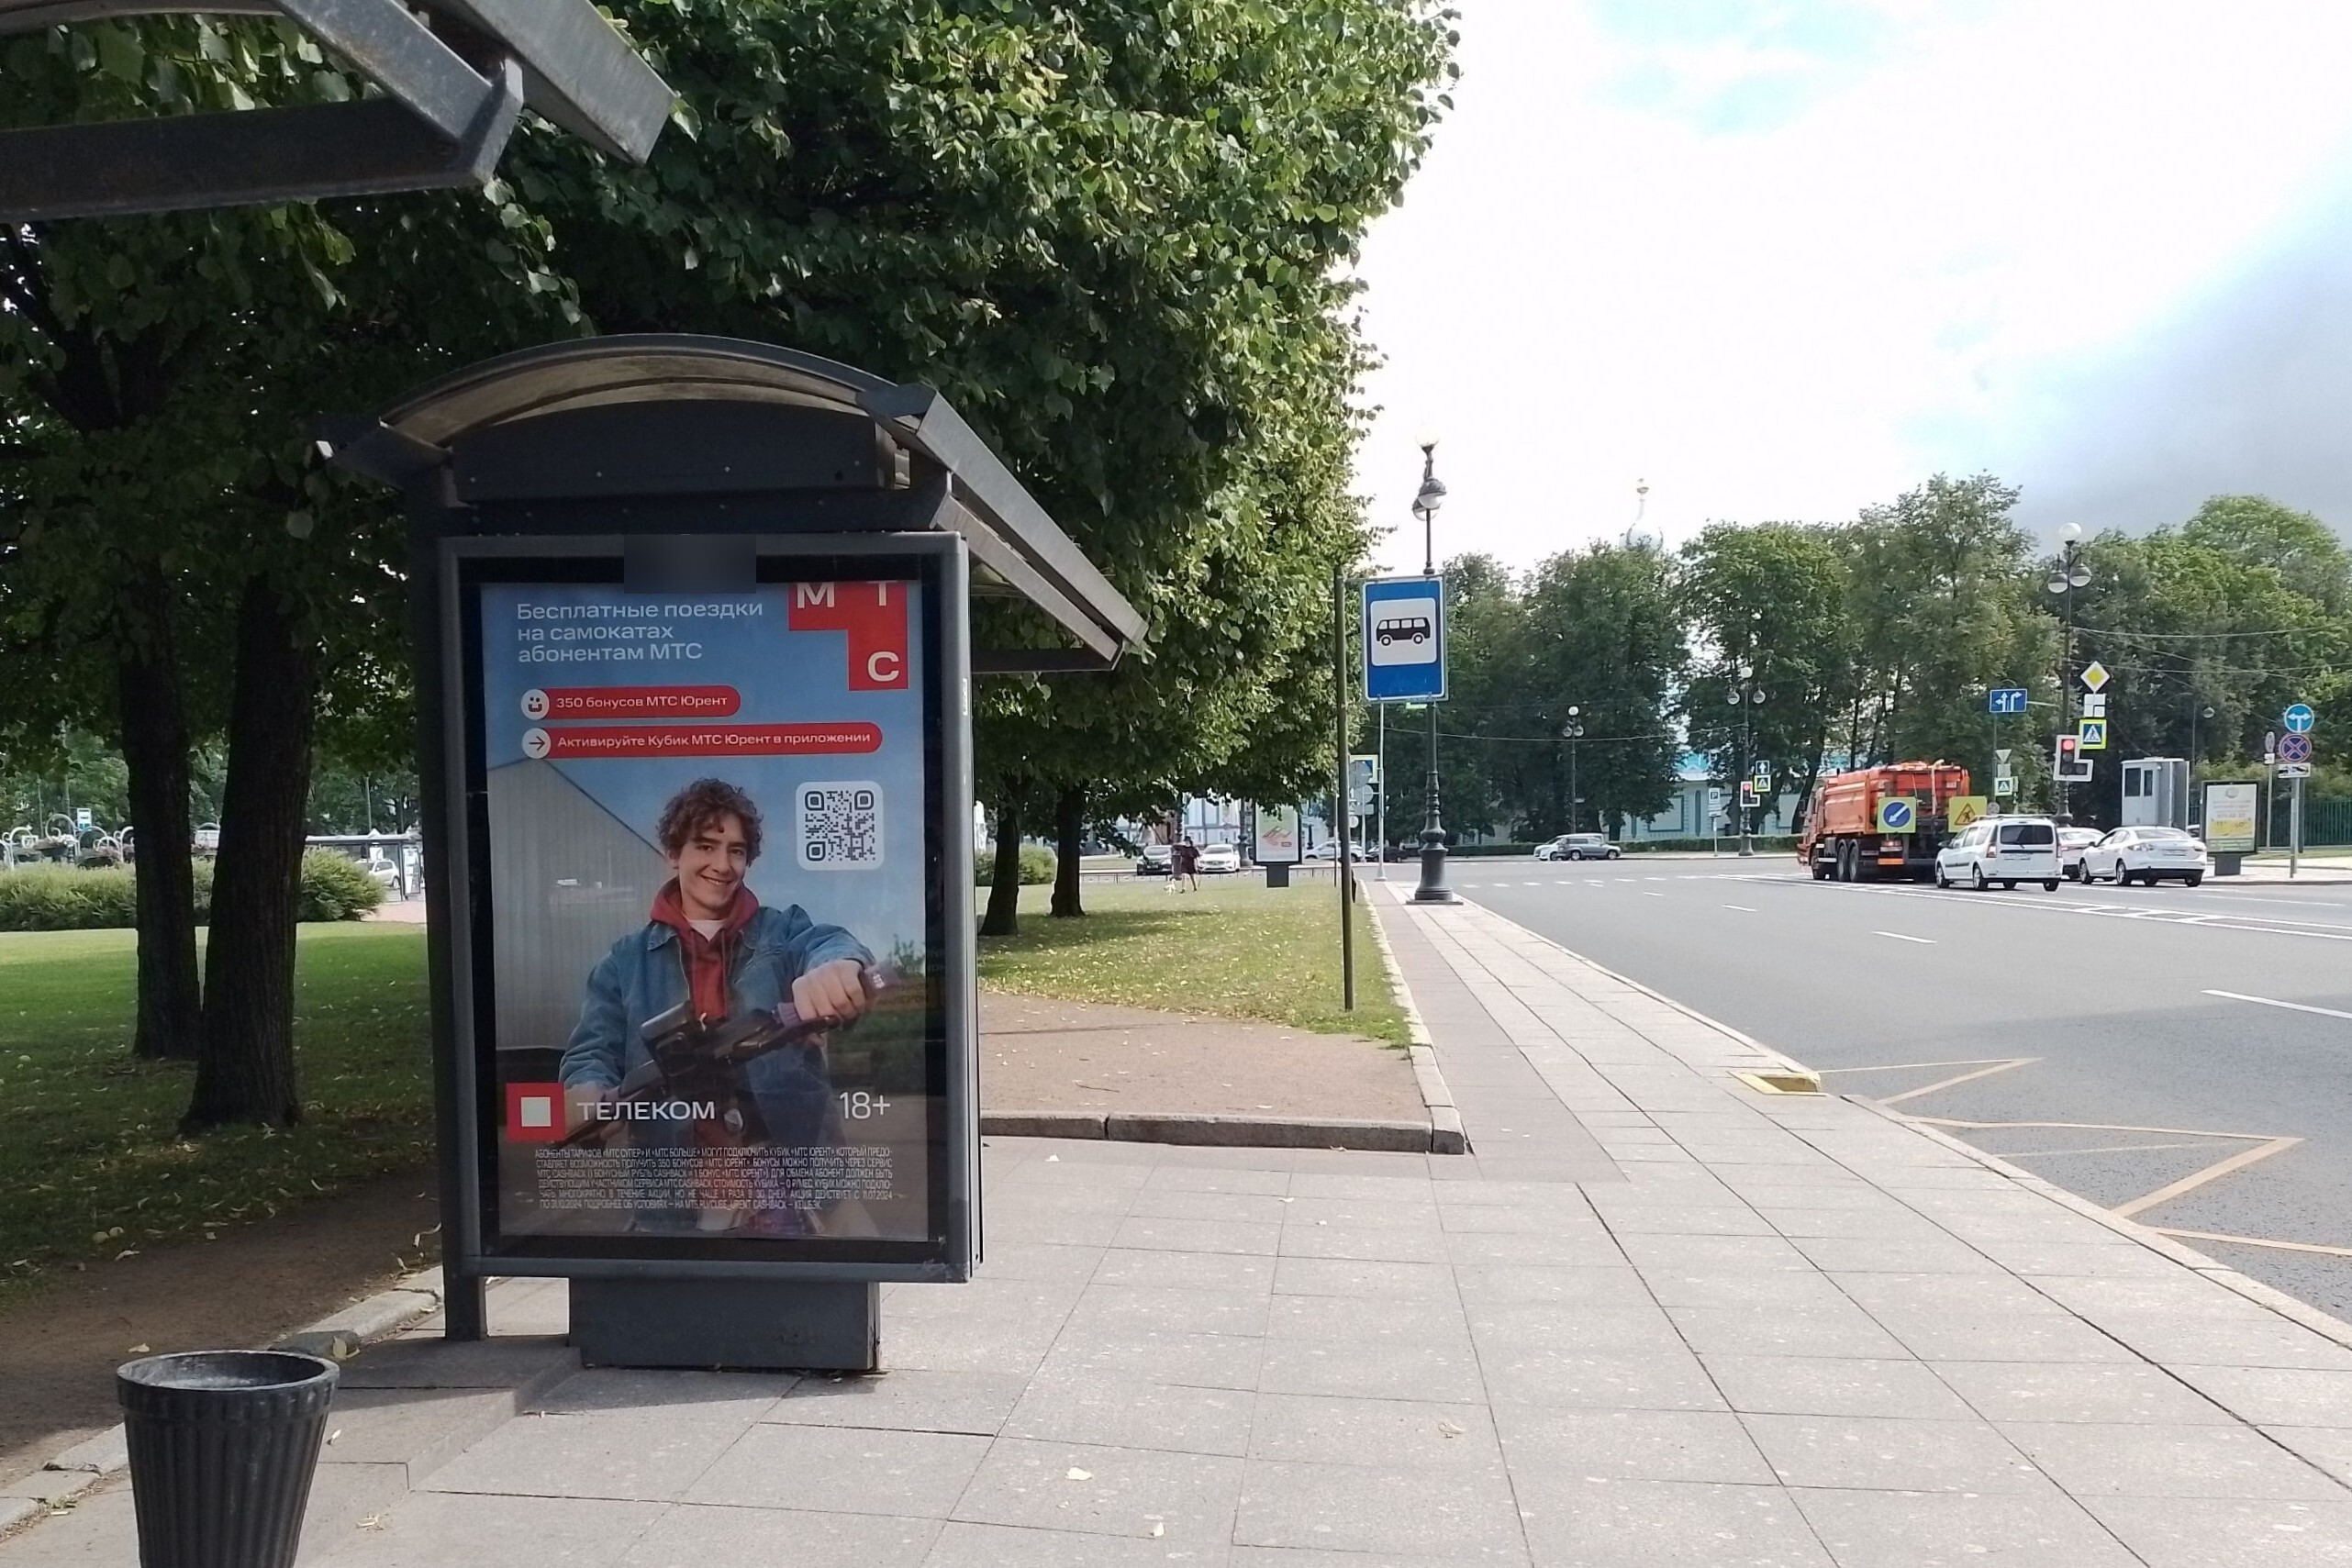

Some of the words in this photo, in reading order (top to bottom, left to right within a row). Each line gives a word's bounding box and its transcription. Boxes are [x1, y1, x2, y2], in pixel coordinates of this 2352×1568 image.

[517, 604, 659, 620] Бесплатные
[663, 602, 763, 619] поездки
[518, 628, 544, 641] на
[550, 625, 674, 640] самокатах
[518, 647, 644, 663] абонентам
[650, 644, 703, 661] МТС
[556, 697, 583, 708] 350
[586, 696, 643, 708] бонусов
[647, 695, 677, 707] МТС
[681, 695, 727, 709] Юрент
[557, 736, 645, 749] Активируйте
[648, 735, 689, 748] Кубик
[692, 734, 722, 745] МТС
[725, 733, 770, 747] Юрент
[774, 735, 781, 743] в
[784, 732, 871, 746] приложении
[576, 1101, 716, 1120] ТЕЛЕКОМ
[839, 1091, 892, 1119] 18+
[702, 1148, 722, 1158] МОГУТ
[723, 1148, 769, 1158] ПОДКЛЮЧИТЬ
[769, 1148, 790, 1158] КУБИК
[657, 1159, 670, 1169] 350
